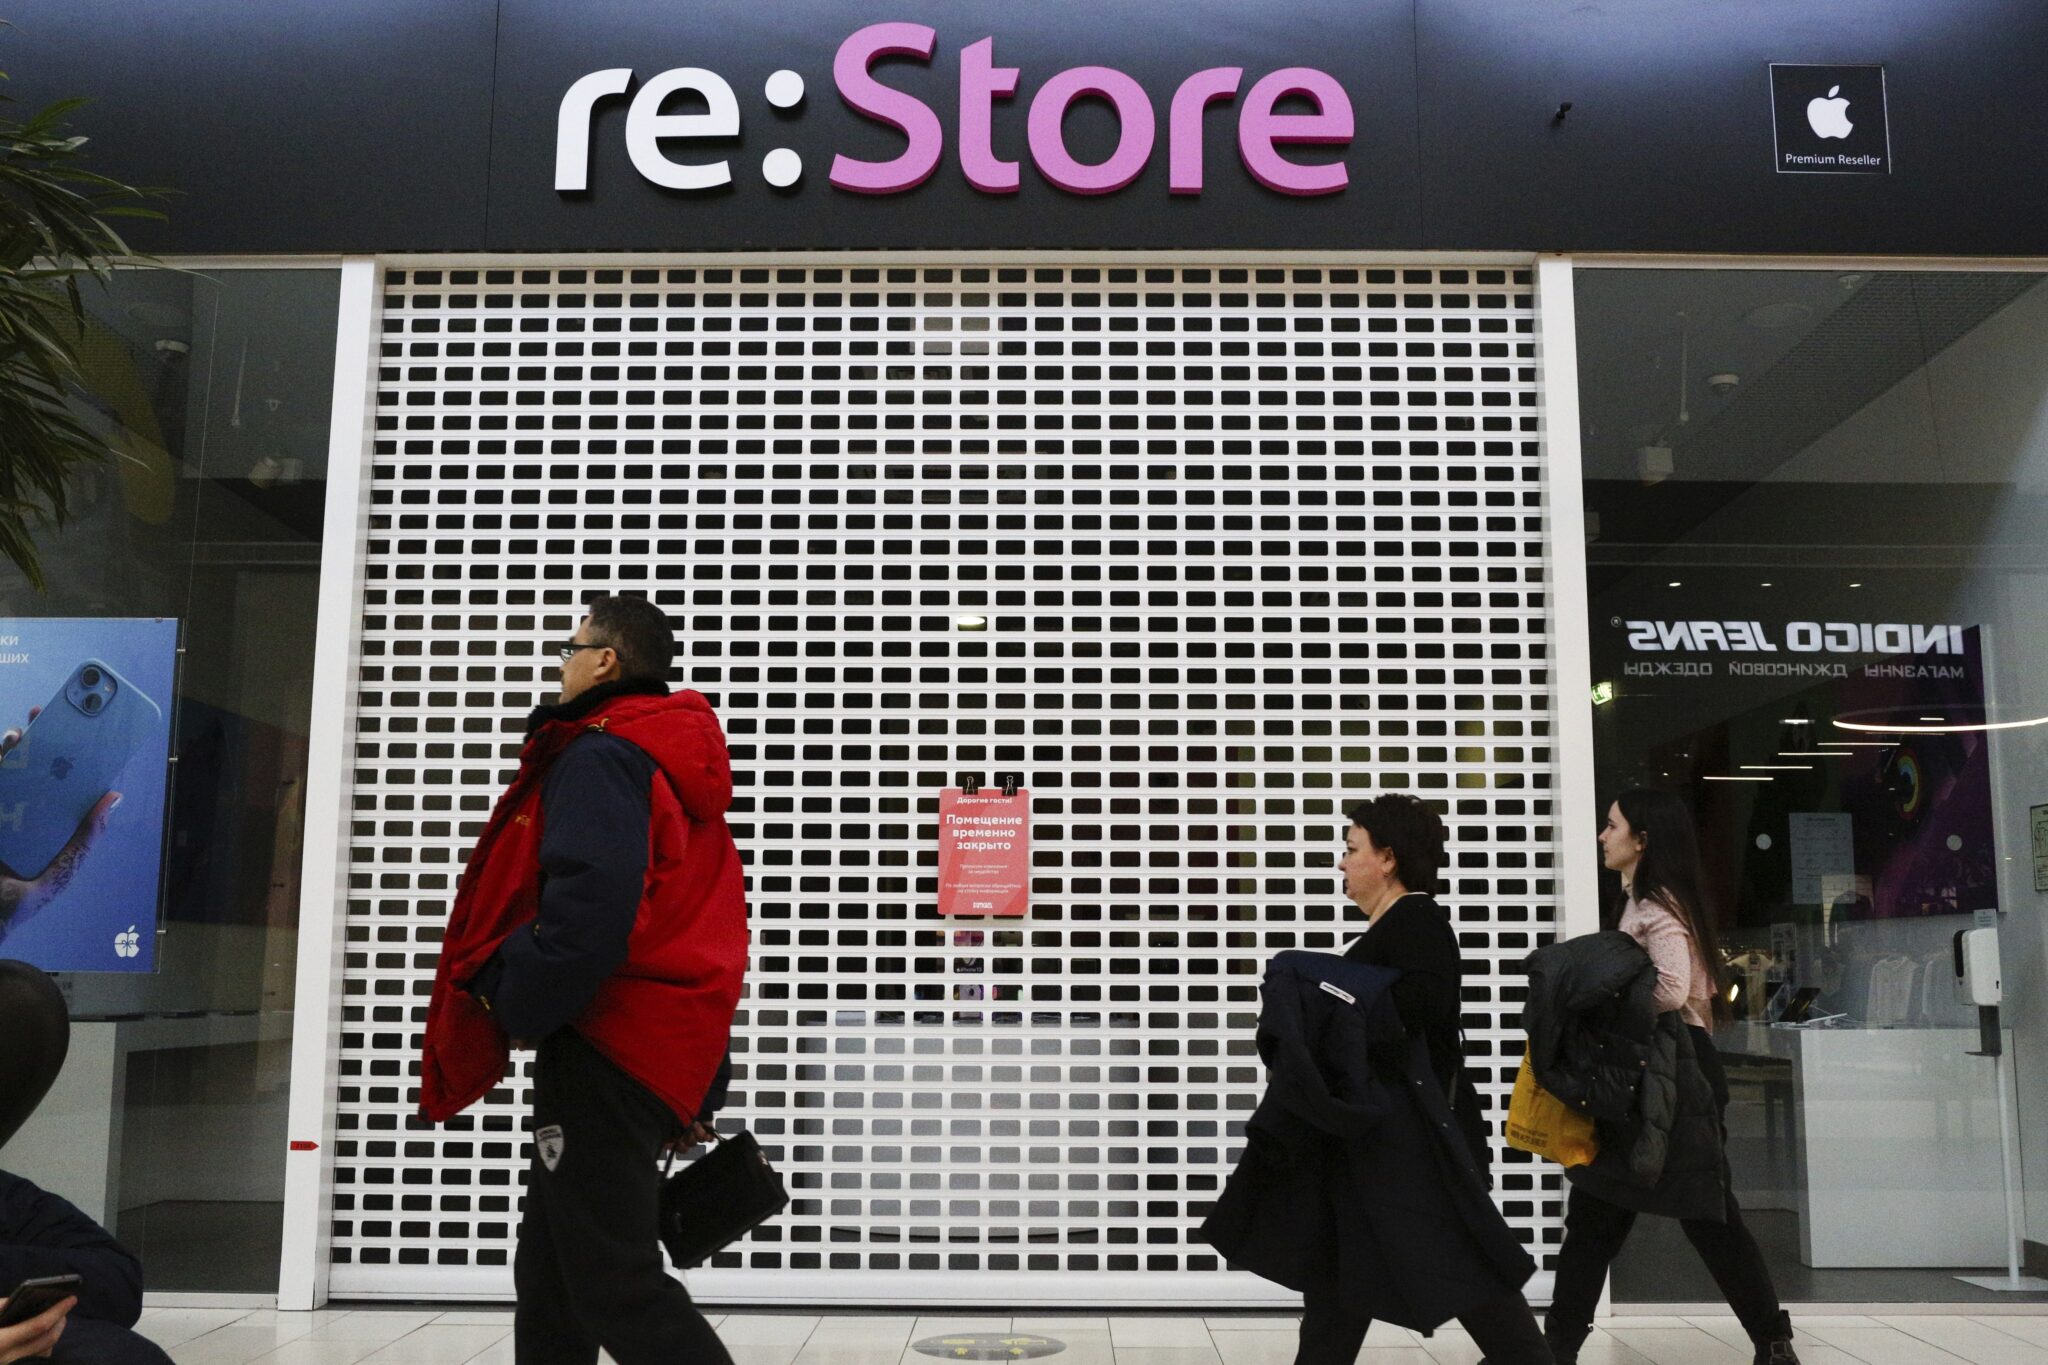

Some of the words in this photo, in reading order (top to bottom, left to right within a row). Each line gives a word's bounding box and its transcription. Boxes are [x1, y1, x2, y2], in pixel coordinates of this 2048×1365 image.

[554, 21, 1355, 196] re:Store
[1785, 153, 1835, 164] Premium
[1838, 154, 1881, 165] Reseller
[946, 814, 1023, 826] Помещение
[952, 829, 1016, 839] временно
[956, 842, 1011, 852] закрыто
